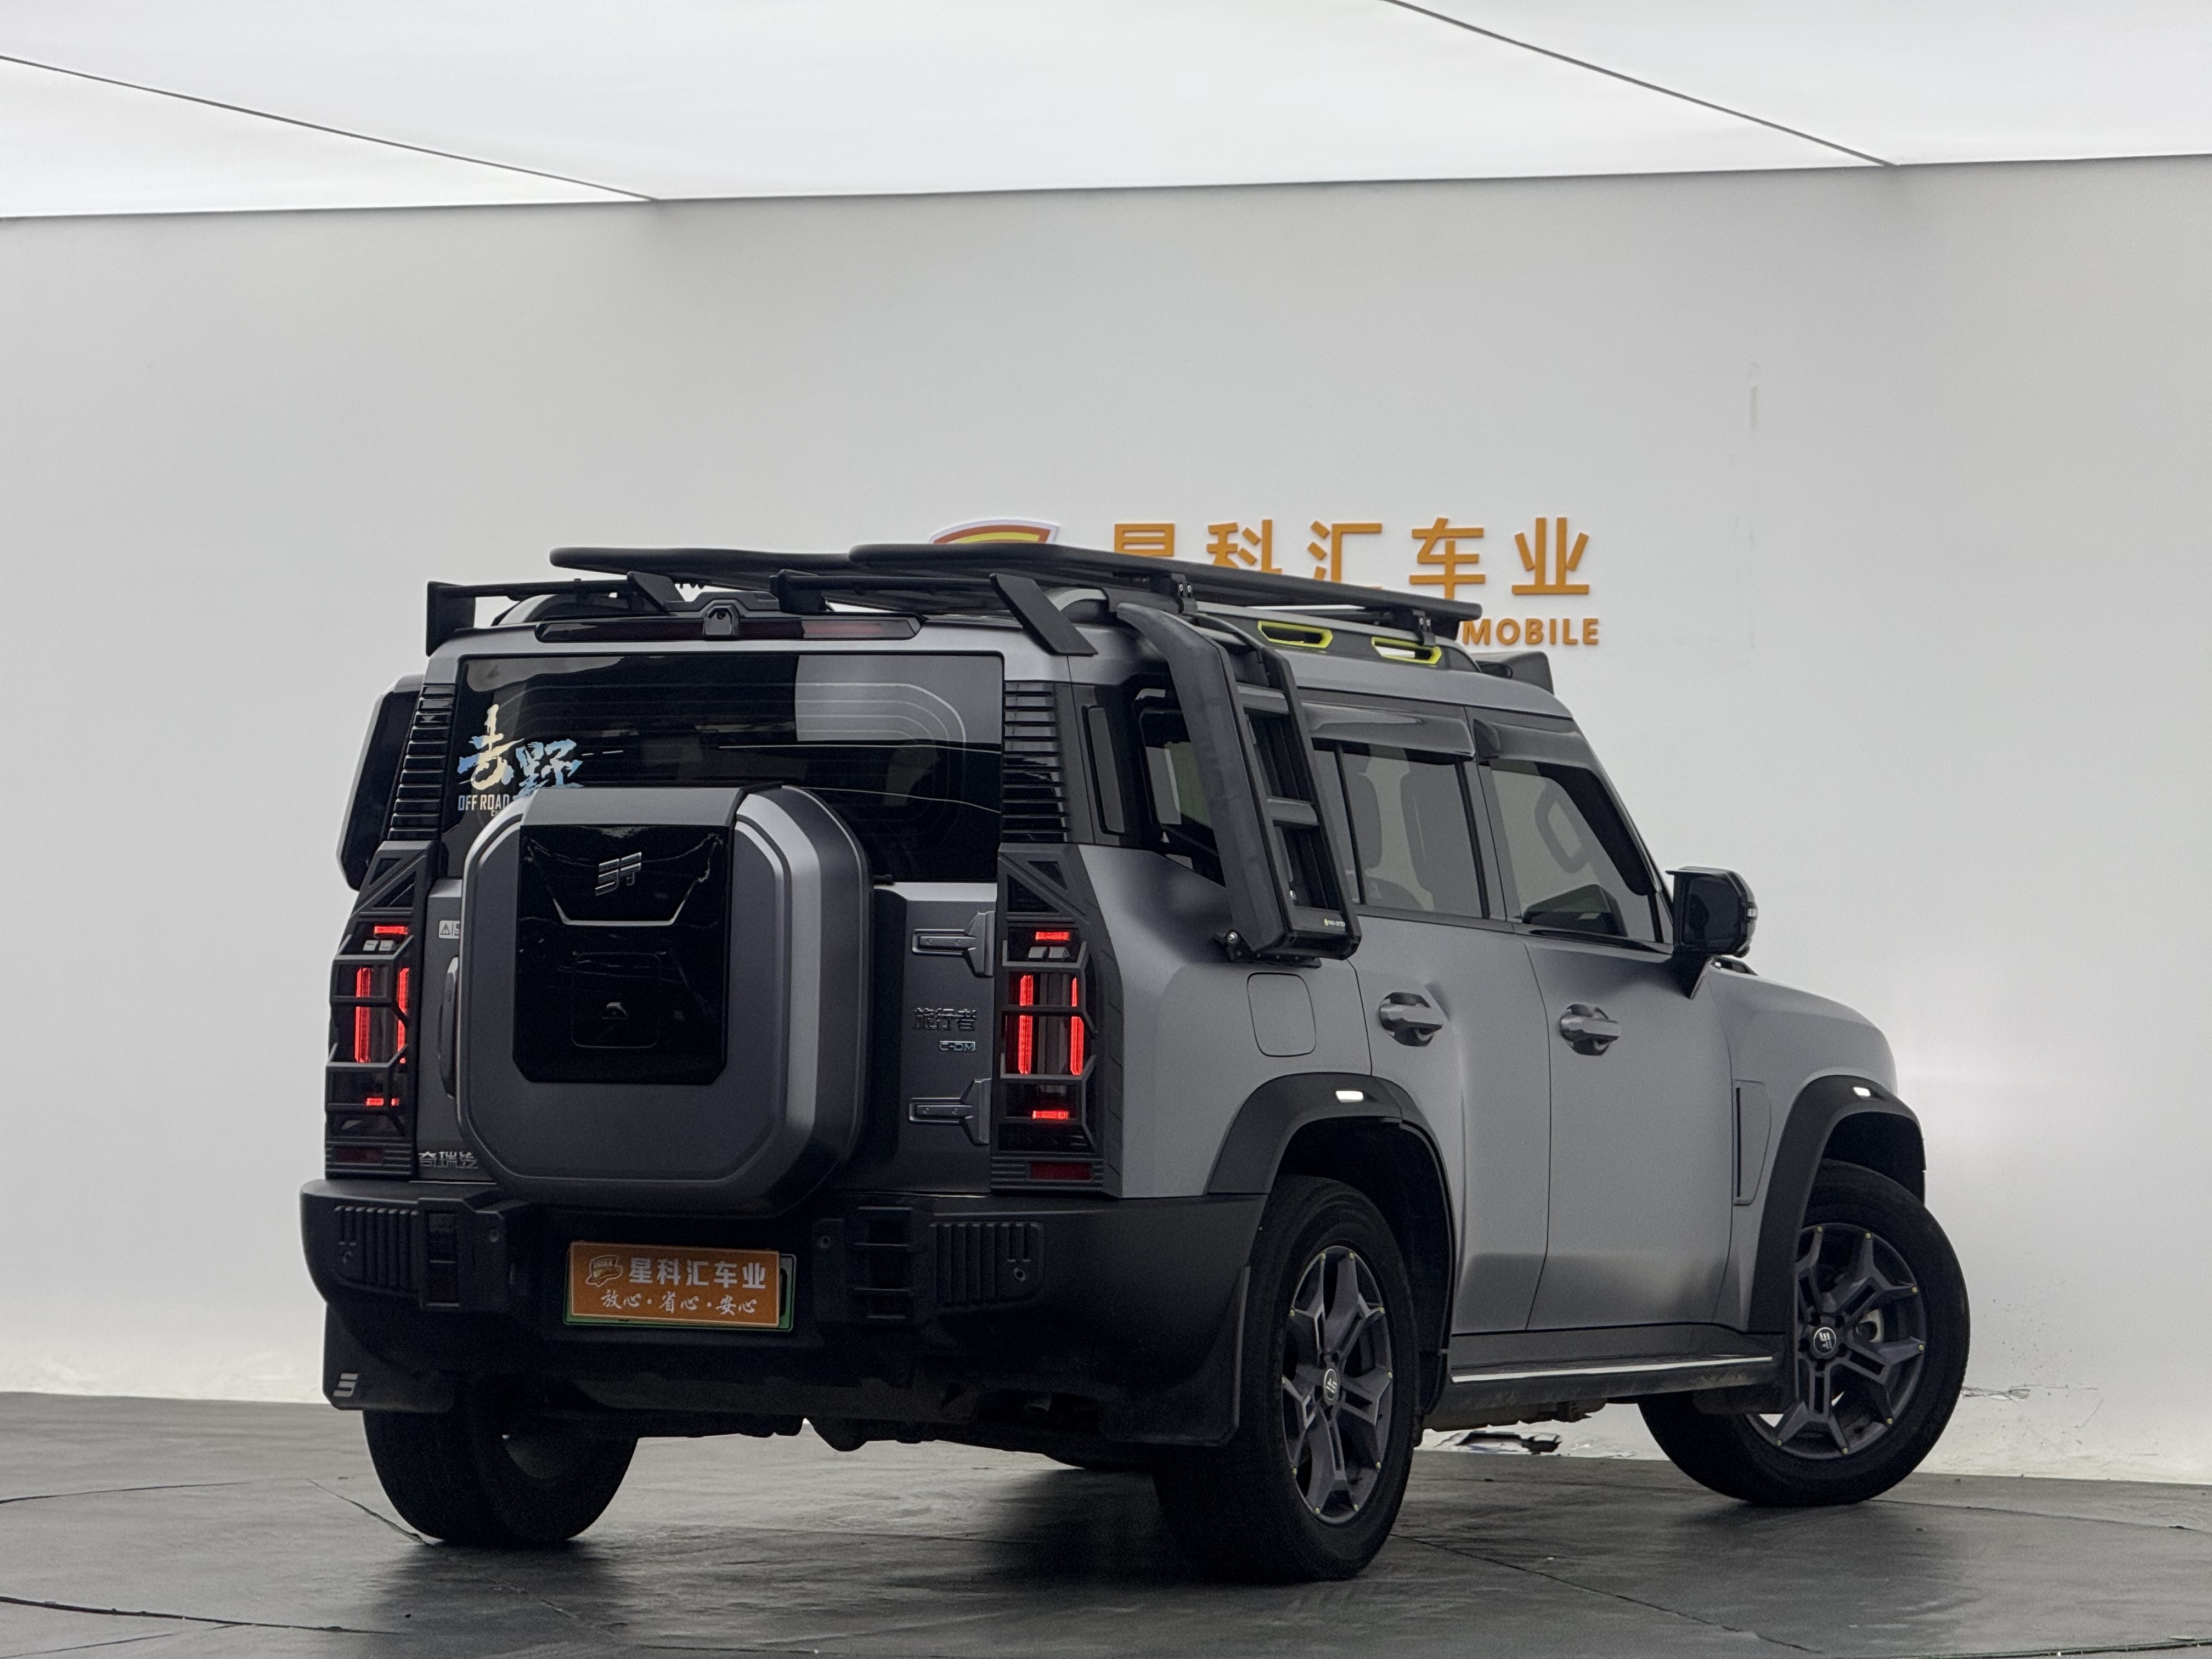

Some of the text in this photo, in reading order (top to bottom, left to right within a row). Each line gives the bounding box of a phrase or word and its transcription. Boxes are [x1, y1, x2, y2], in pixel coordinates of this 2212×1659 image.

[458, 794, 510, 811] OFF ROAD
[914, 1007, 977, 1031] 旅行者
[628, 1257, 766, 1290] 星科汇车业
